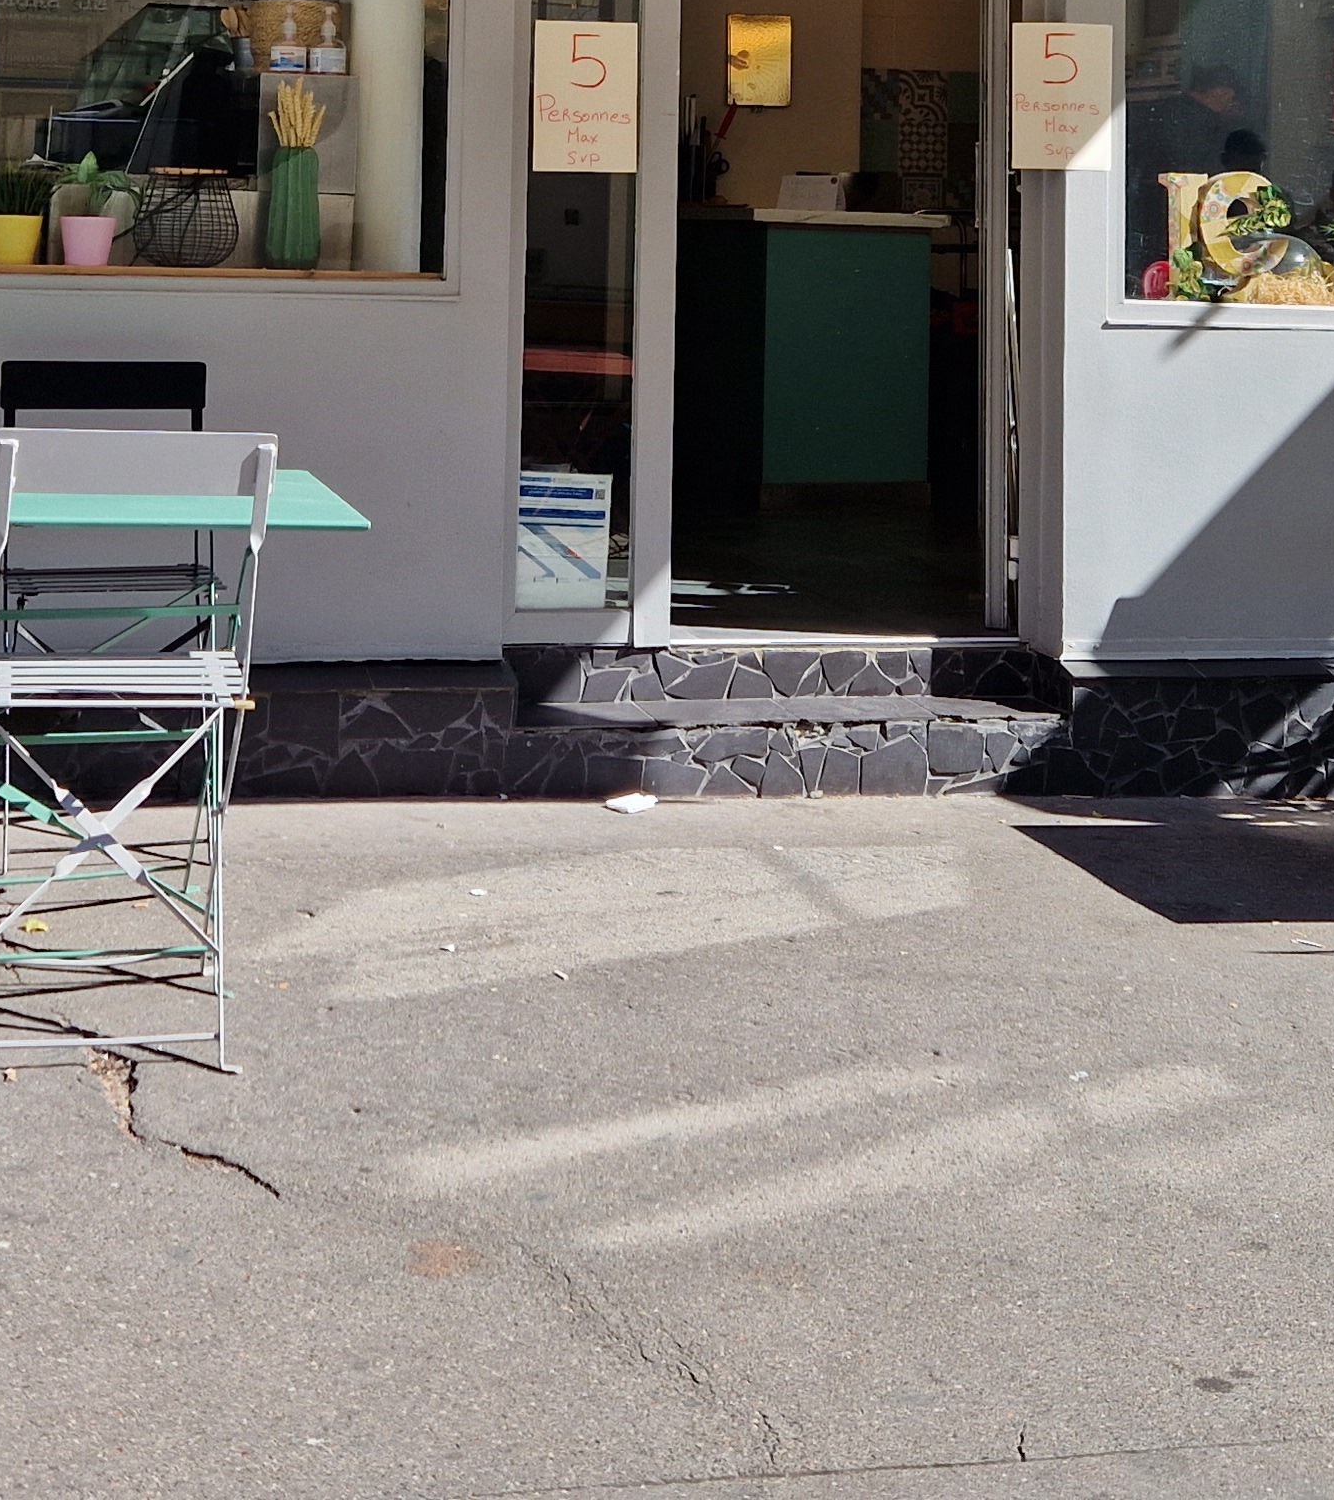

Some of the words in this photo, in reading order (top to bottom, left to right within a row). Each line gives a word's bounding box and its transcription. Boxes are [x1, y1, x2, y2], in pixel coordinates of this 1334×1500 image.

[570, 33, 607, 89] 5
[1043, 33, 1079, 84] 5
[567, 127, 598, 145] Max
[1044, 118, 1079, 134] Max
